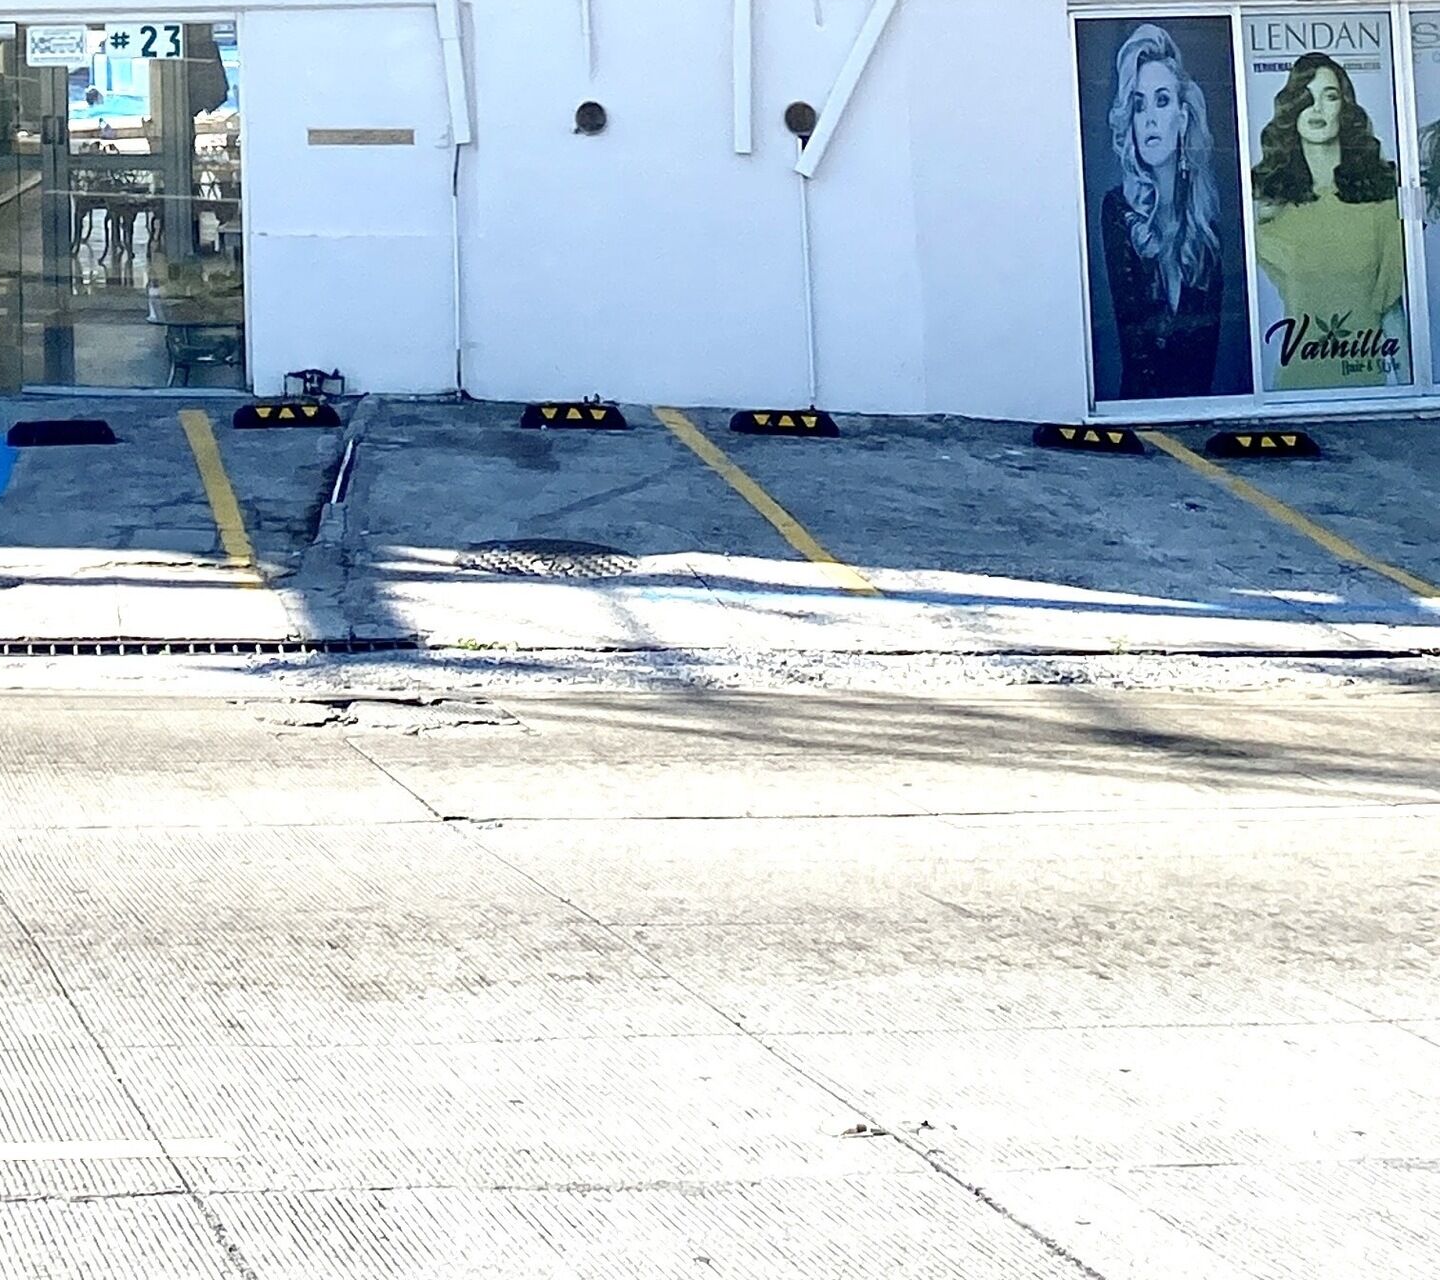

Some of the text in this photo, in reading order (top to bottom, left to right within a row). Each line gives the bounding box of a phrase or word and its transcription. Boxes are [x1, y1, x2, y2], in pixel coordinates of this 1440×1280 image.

[140, 25, 180, 58] 23
[1250, 20, 1380, 51] LENDAN
[1265, 313, 1401, 367] Vainilla
